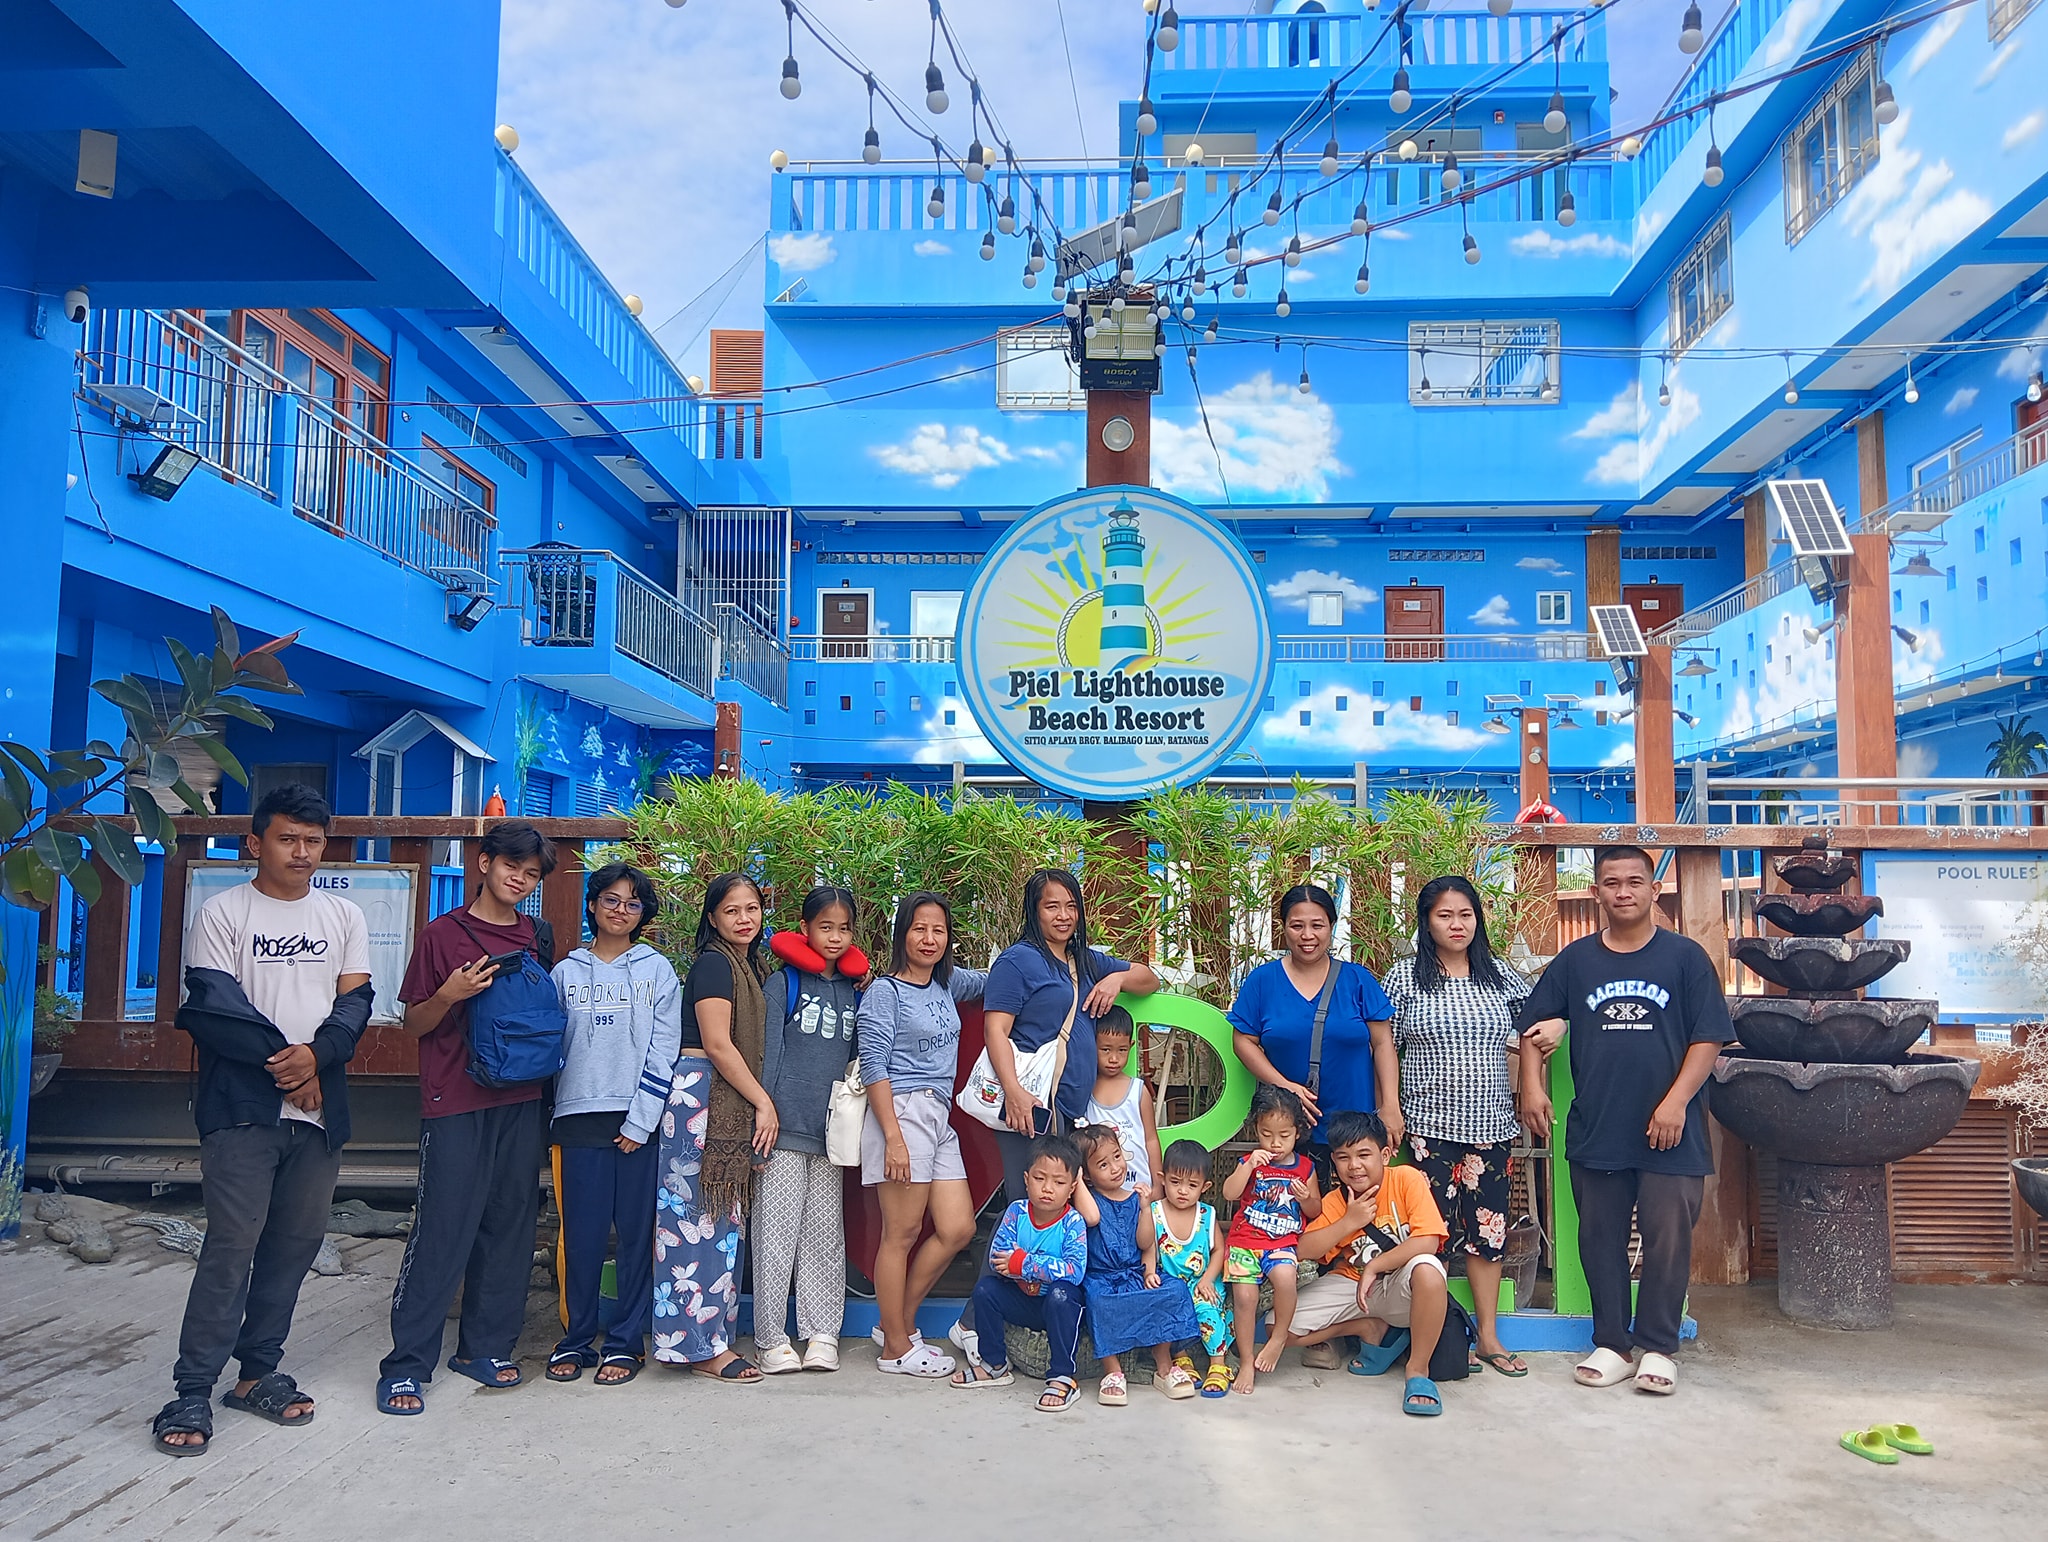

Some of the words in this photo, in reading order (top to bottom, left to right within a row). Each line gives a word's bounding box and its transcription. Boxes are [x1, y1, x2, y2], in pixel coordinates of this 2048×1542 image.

[1009, 669, 1061, 698] Piel
[1073, 669, 1225, 704] Lighthouse
[1028, 705, 1108, 731] Beach
[1114, 705, 1206, 731] Resort
[1048, 736, 1077, 745] APLAYA
[1103, 736, 1143, 745] BALIBAGO
[1144, 736, 1166, 746] LIAN,
[1167, 736, 1209, 745] BATANGAS
[308, 876, 350, 889] ULES
[1937, 866, 1983, 880] POOL
[1987, 866, 2039, 880] RULES
[567, 980, 656, 1009] ROOKLYN
[1585, 979, 1671, 1013] BACHELOR
[1243, 1205, 1301, 1230] CAPTAIN
[1248, 1216, 1292, 1236] AMER
